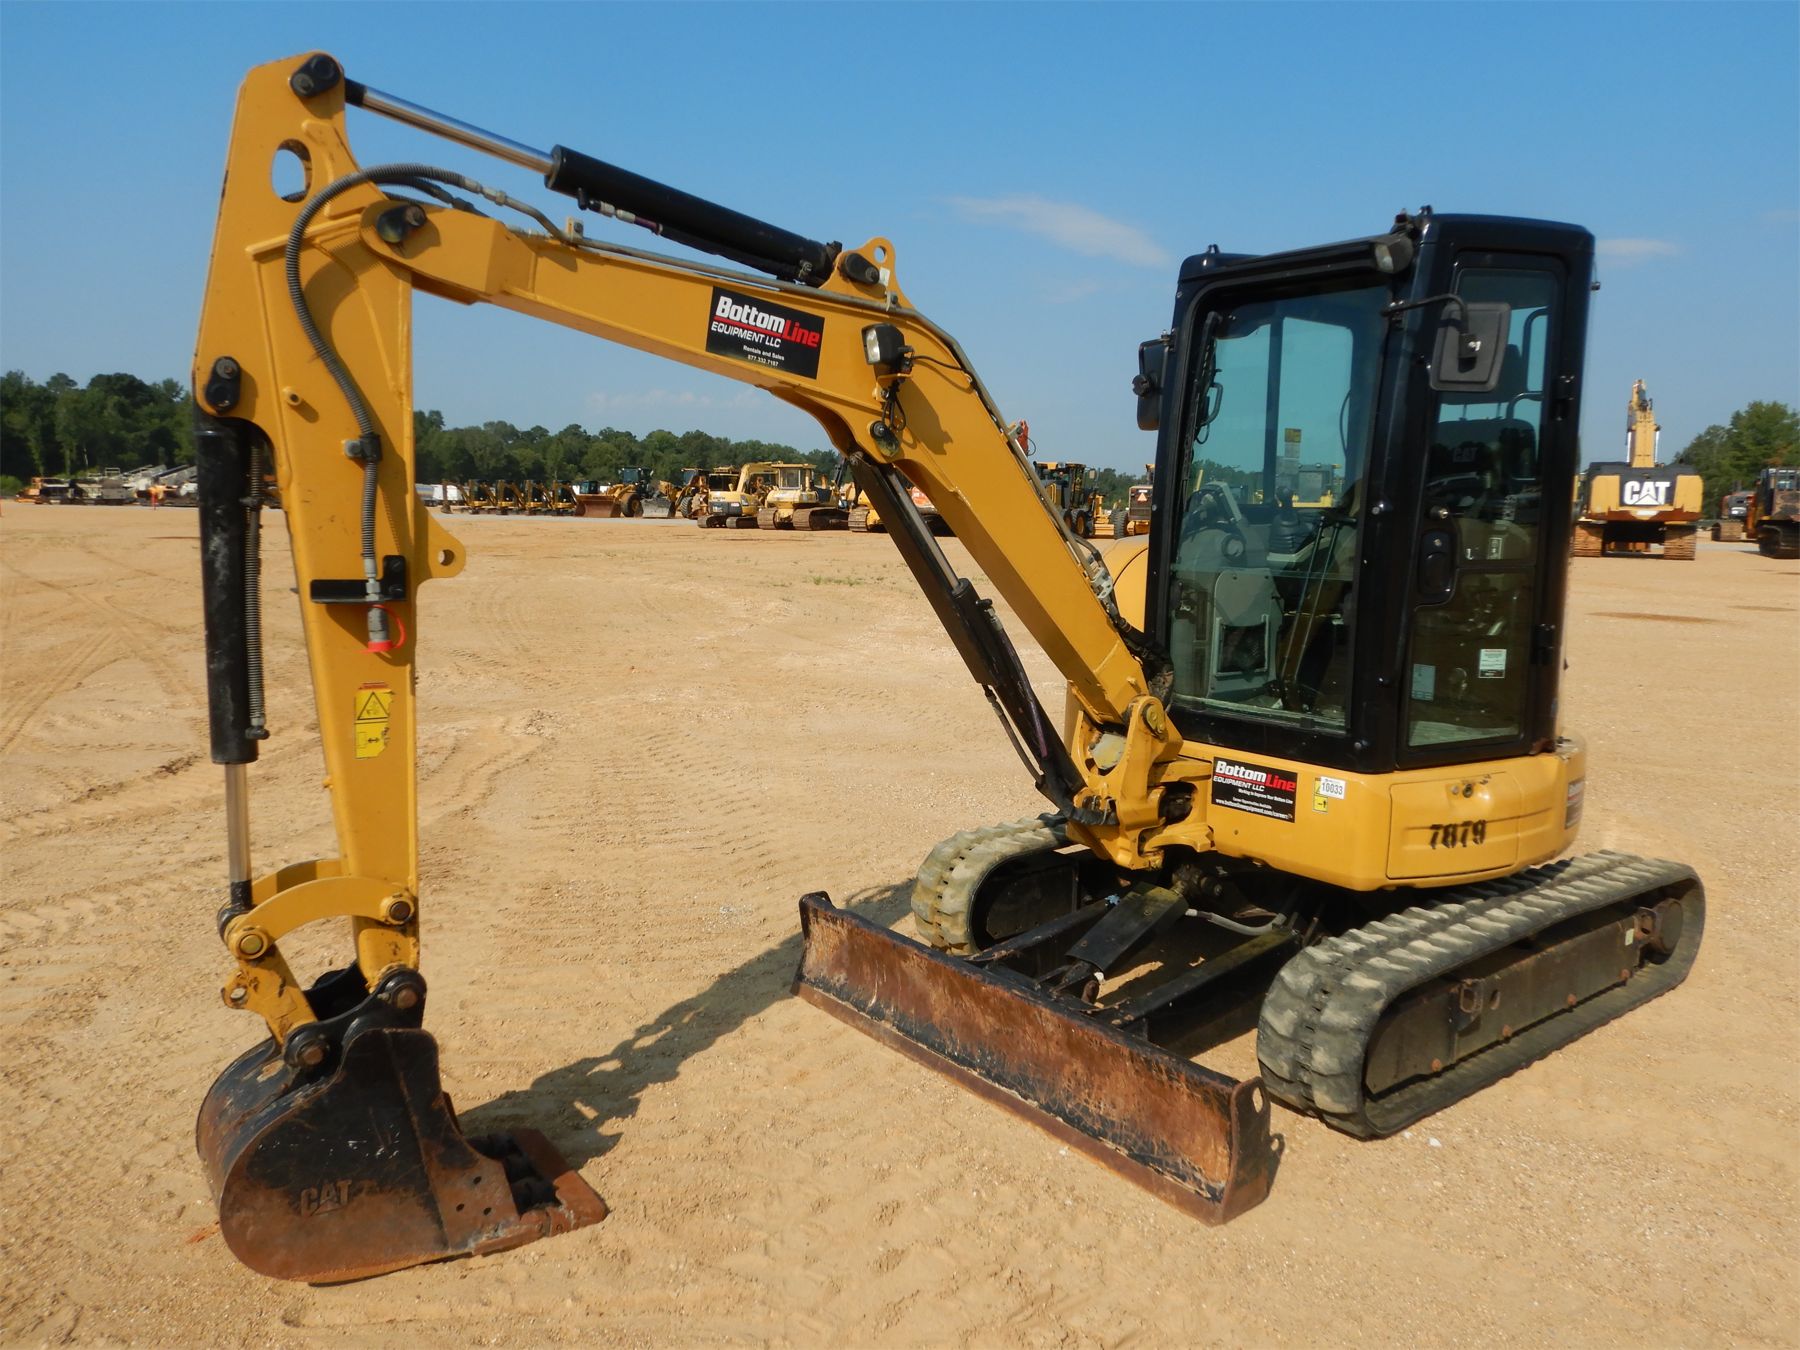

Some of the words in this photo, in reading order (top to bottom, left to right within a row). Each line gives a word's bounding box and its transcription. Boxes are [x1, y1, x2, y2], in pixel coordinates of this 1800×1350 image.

[711, 321, 765, 343] EQUIPMENT
[765, 338, 781, 348] LLC
[1624, 480, 1670, 505] CAT
[1213, 775, 1252, 789] EQUIPMENT
[1252, 784, 1265, 792] LLC
[1321, 782, 1343, 796] 10033
[1429, 819, 1487, 850] 7879
[301, 1180, 352, 1217] CAT
